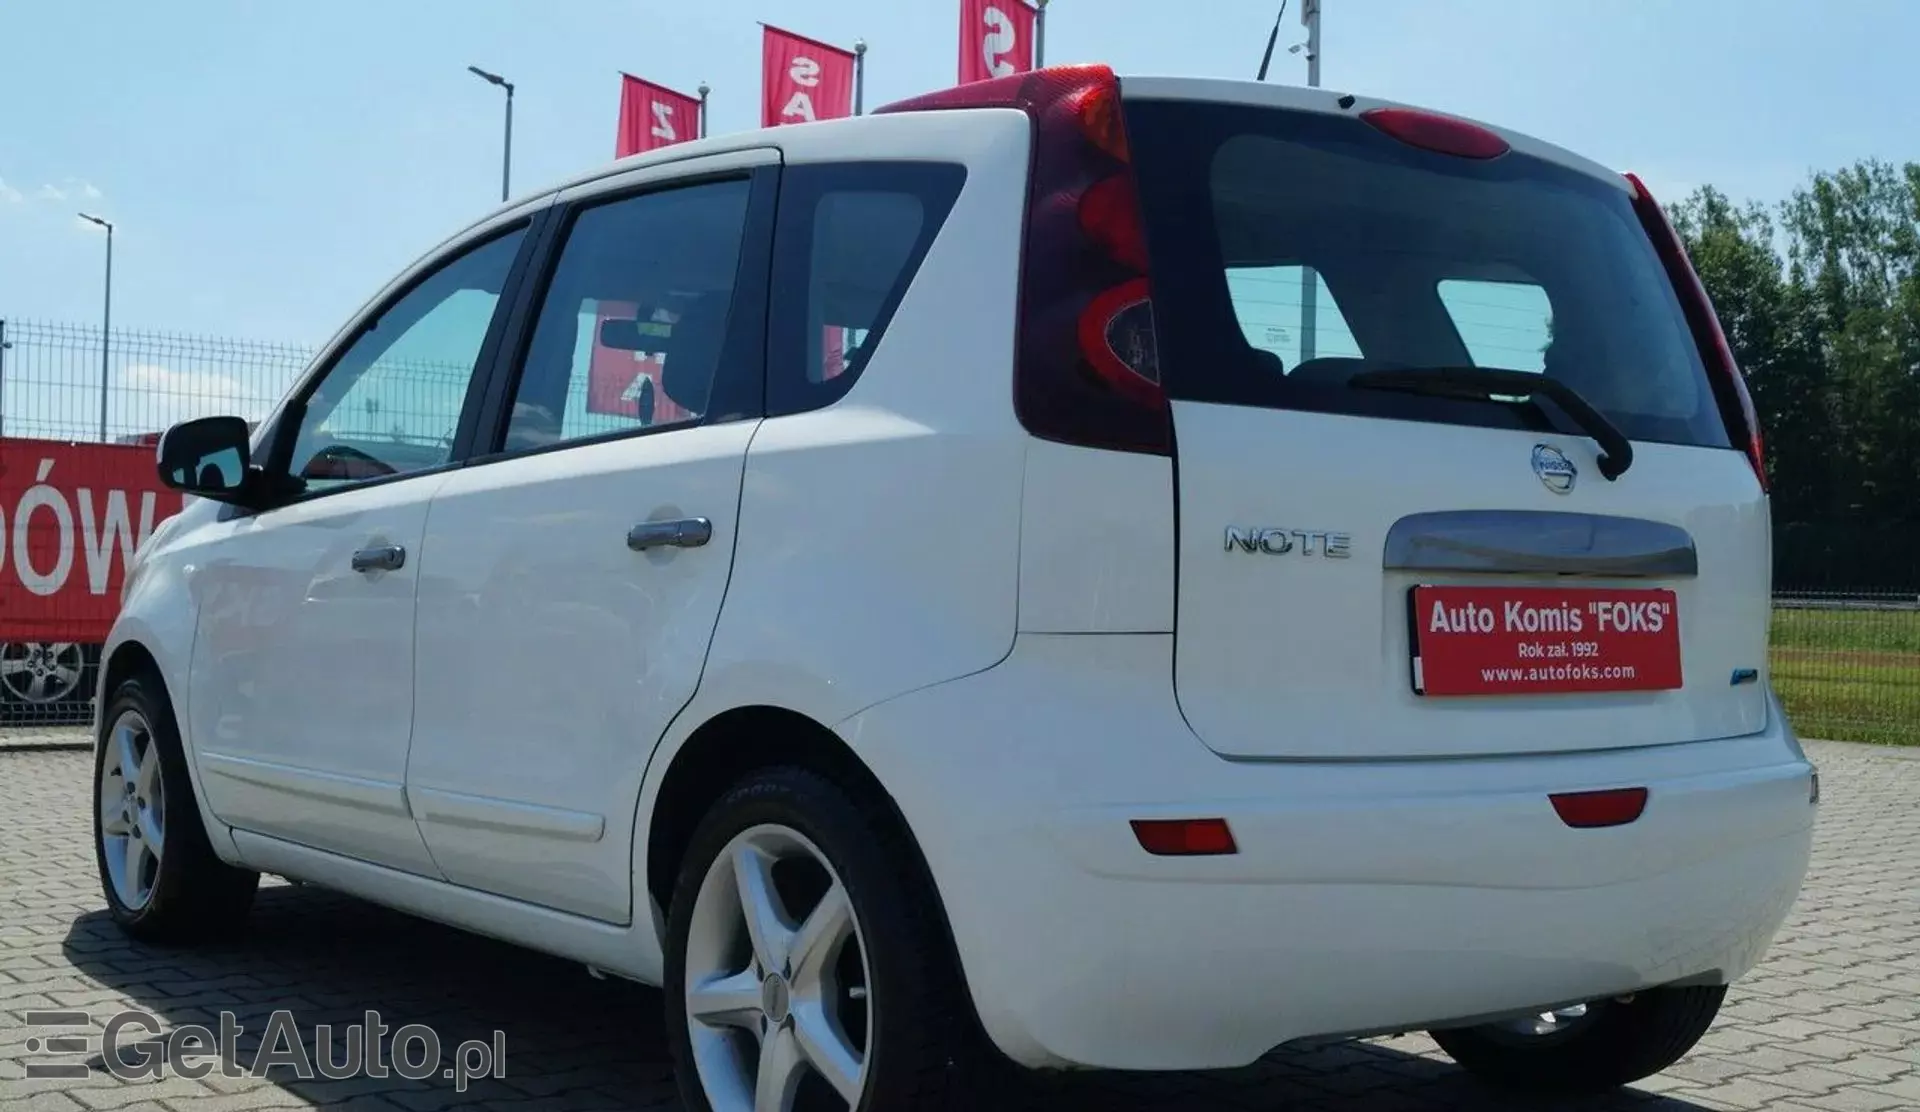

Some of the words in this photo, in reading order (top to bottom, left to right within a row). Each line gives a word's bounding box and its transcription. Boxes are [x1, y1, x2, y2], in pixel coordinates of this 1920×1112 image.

[0, 458, 157, 596] ÓW
[1225, 525, 1351, 559] NOTE
[1430, 600, 1494, 632] Auto
[1504, 601, 1583, 632] Komis
[1589, 601, 1670, 632] "FOKS"
[1519, 642, 1543, 657] Rok
[1547, 642, 1569, 657] zał.
[1571, 642, 1599, 657] 1992
[1481, 664, 1635, 682] www.autofoks.com
